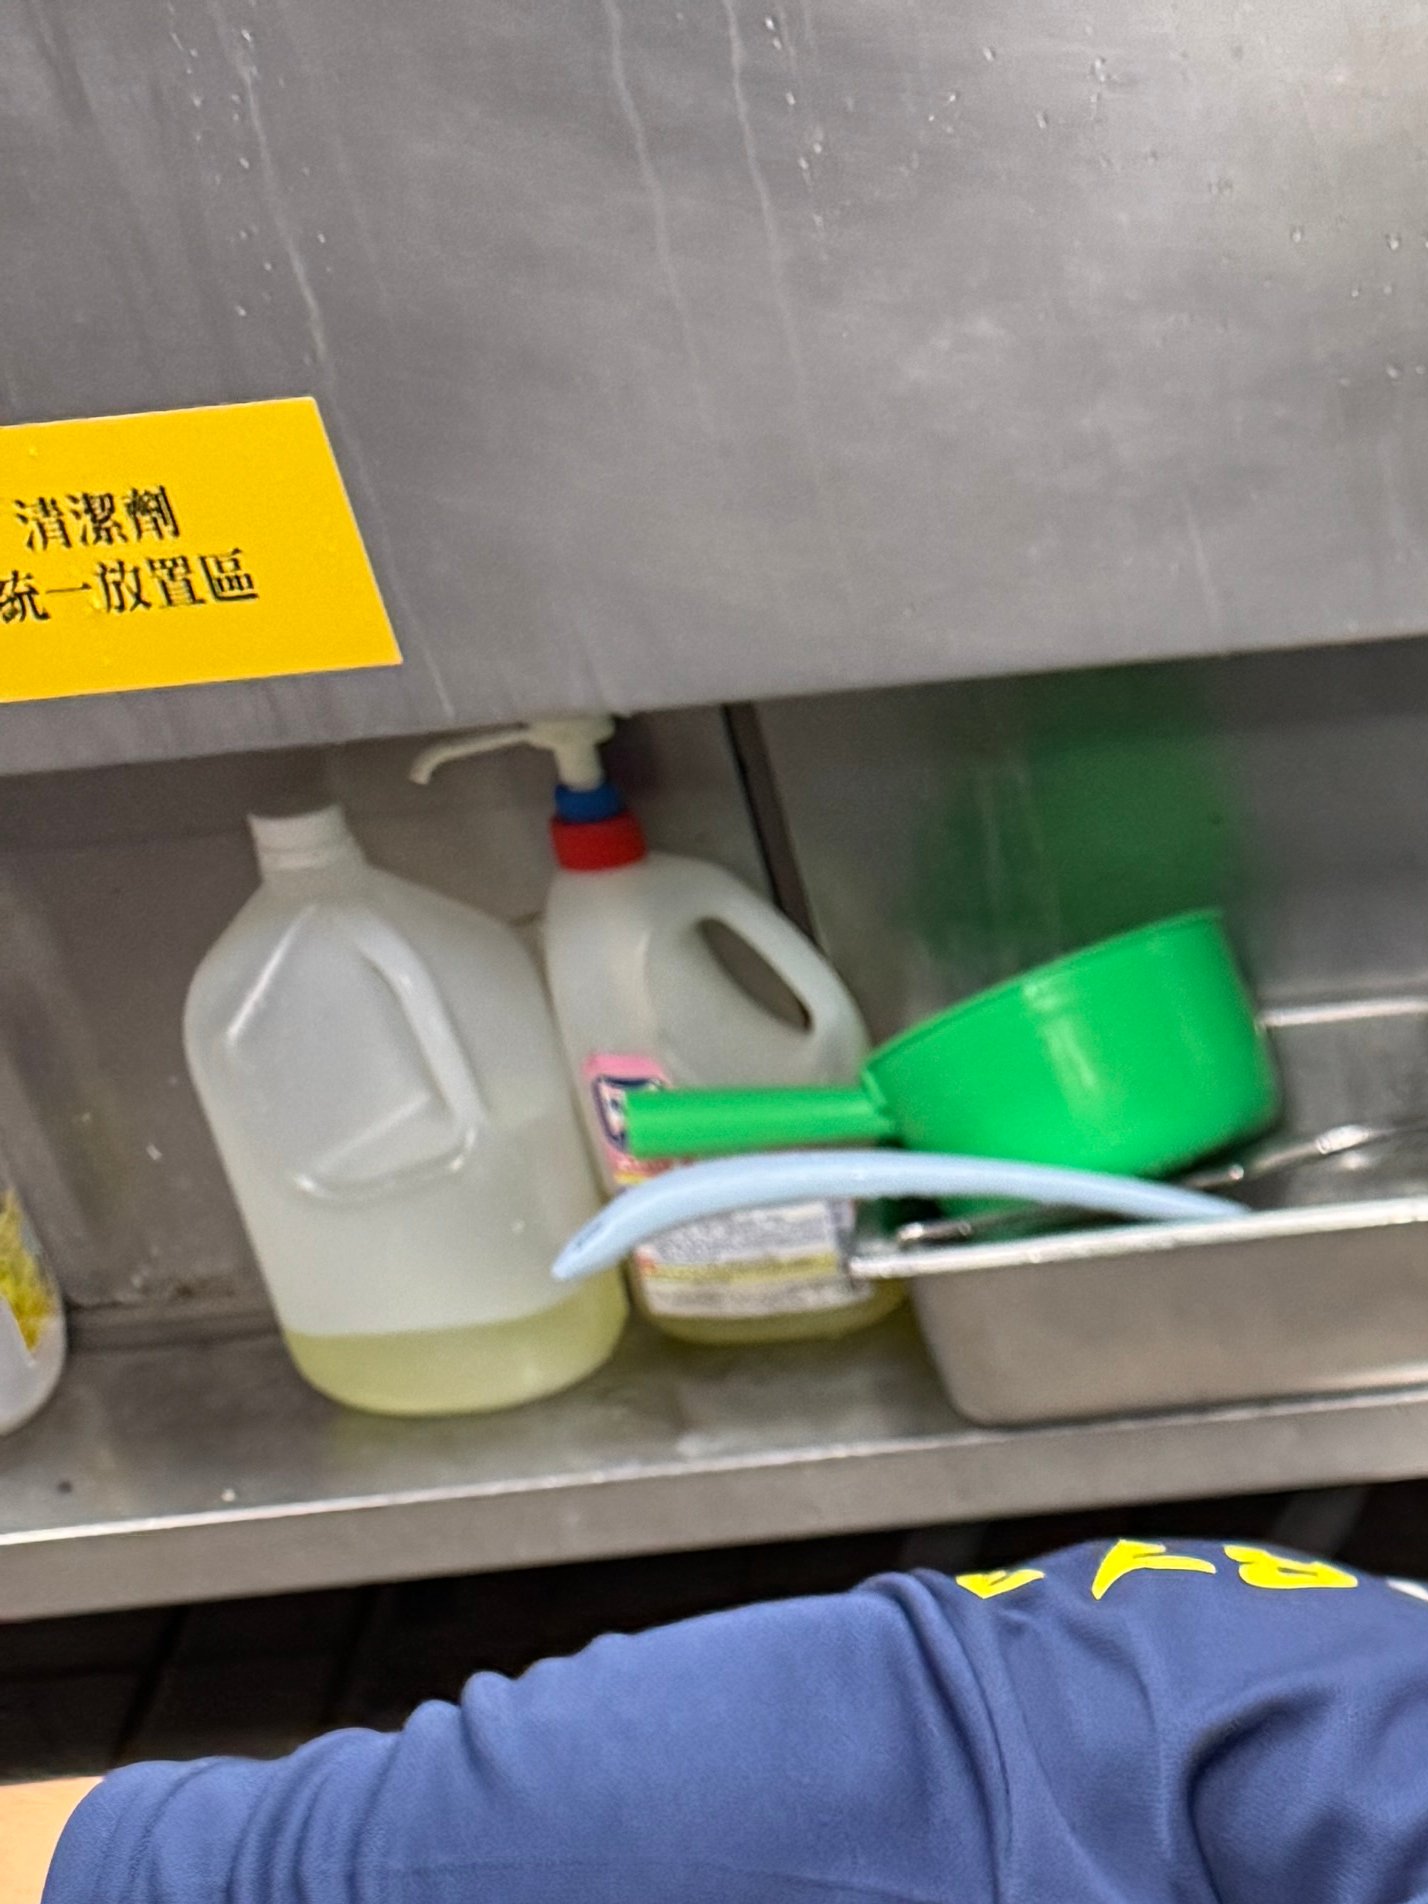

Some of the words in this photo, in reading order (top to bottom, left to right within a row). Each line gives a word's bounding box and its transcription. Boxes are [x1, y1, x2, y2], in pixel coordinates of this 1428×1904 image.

[14, 485, 181, 550] 清潔劑
[0, 548, 259, 624] 統一放置區
